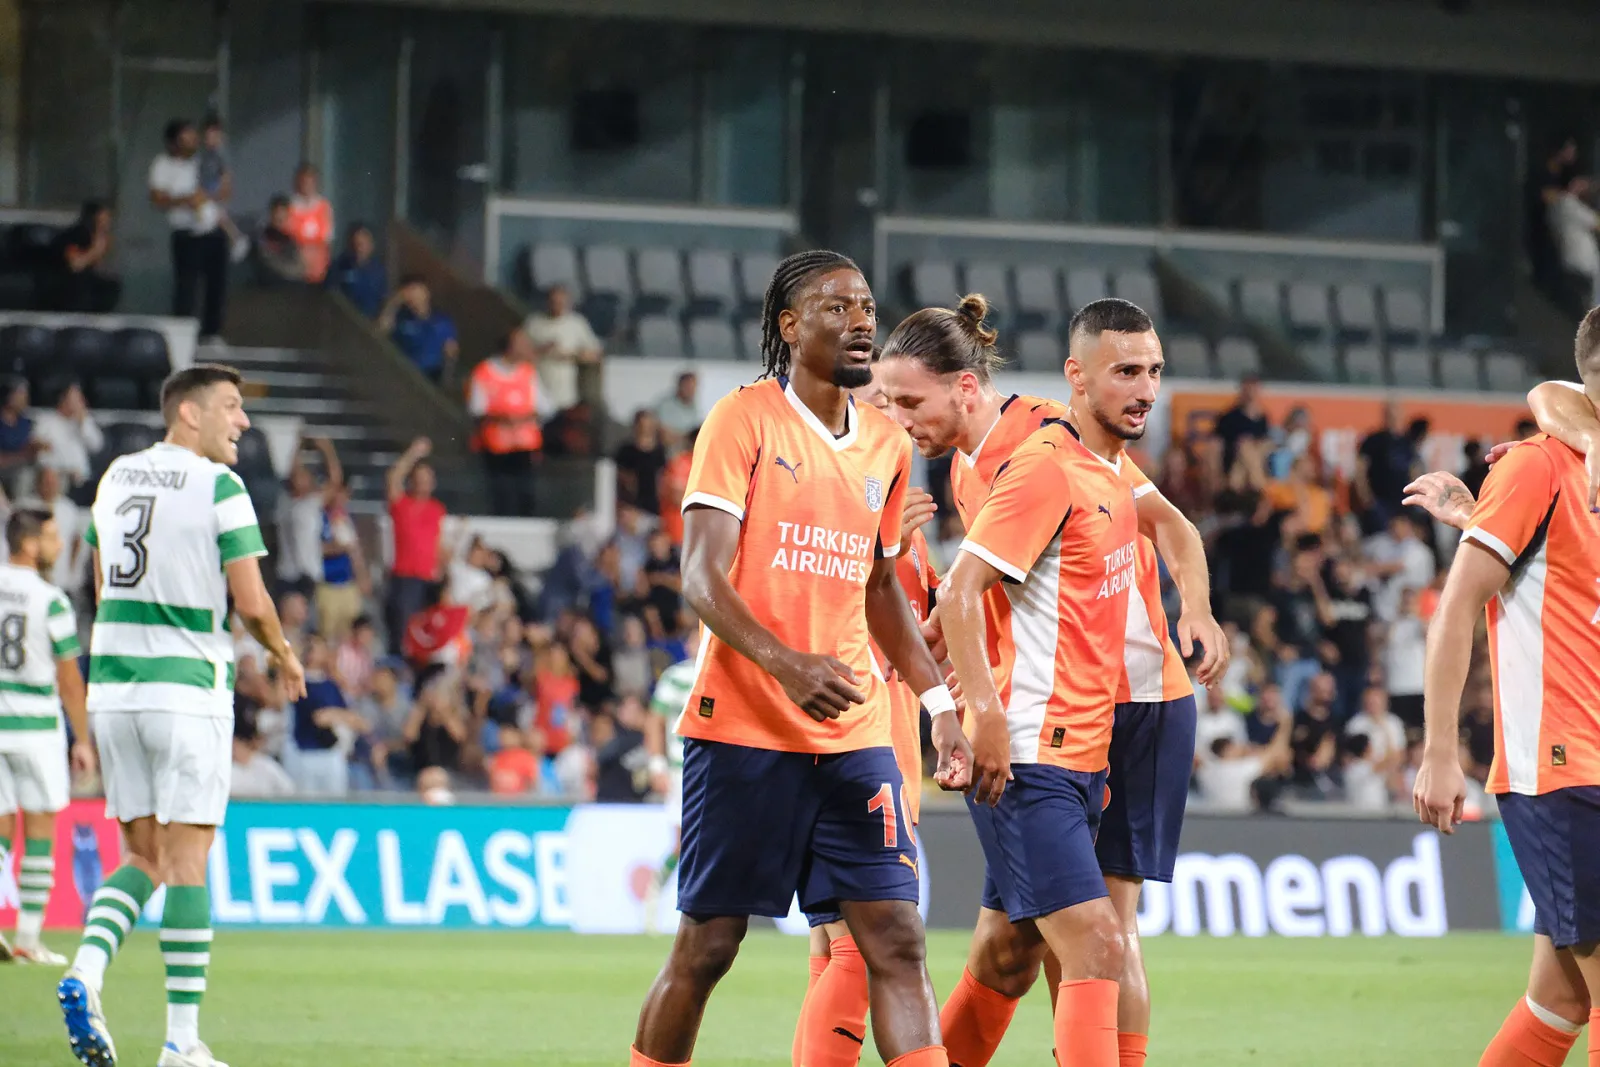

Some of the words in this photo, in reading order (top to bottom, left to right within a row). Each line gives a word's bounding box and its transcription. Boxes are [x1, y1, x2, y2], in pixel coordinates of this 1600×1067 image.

[110, 495, 156, 588] 3
[777, 521, 870, 557] TURKISH
[771, 547, 866, 583] AIRLINES
[1103, 541, 1136, 575] TURKIS
[143, 826, 365, 922] LEX
